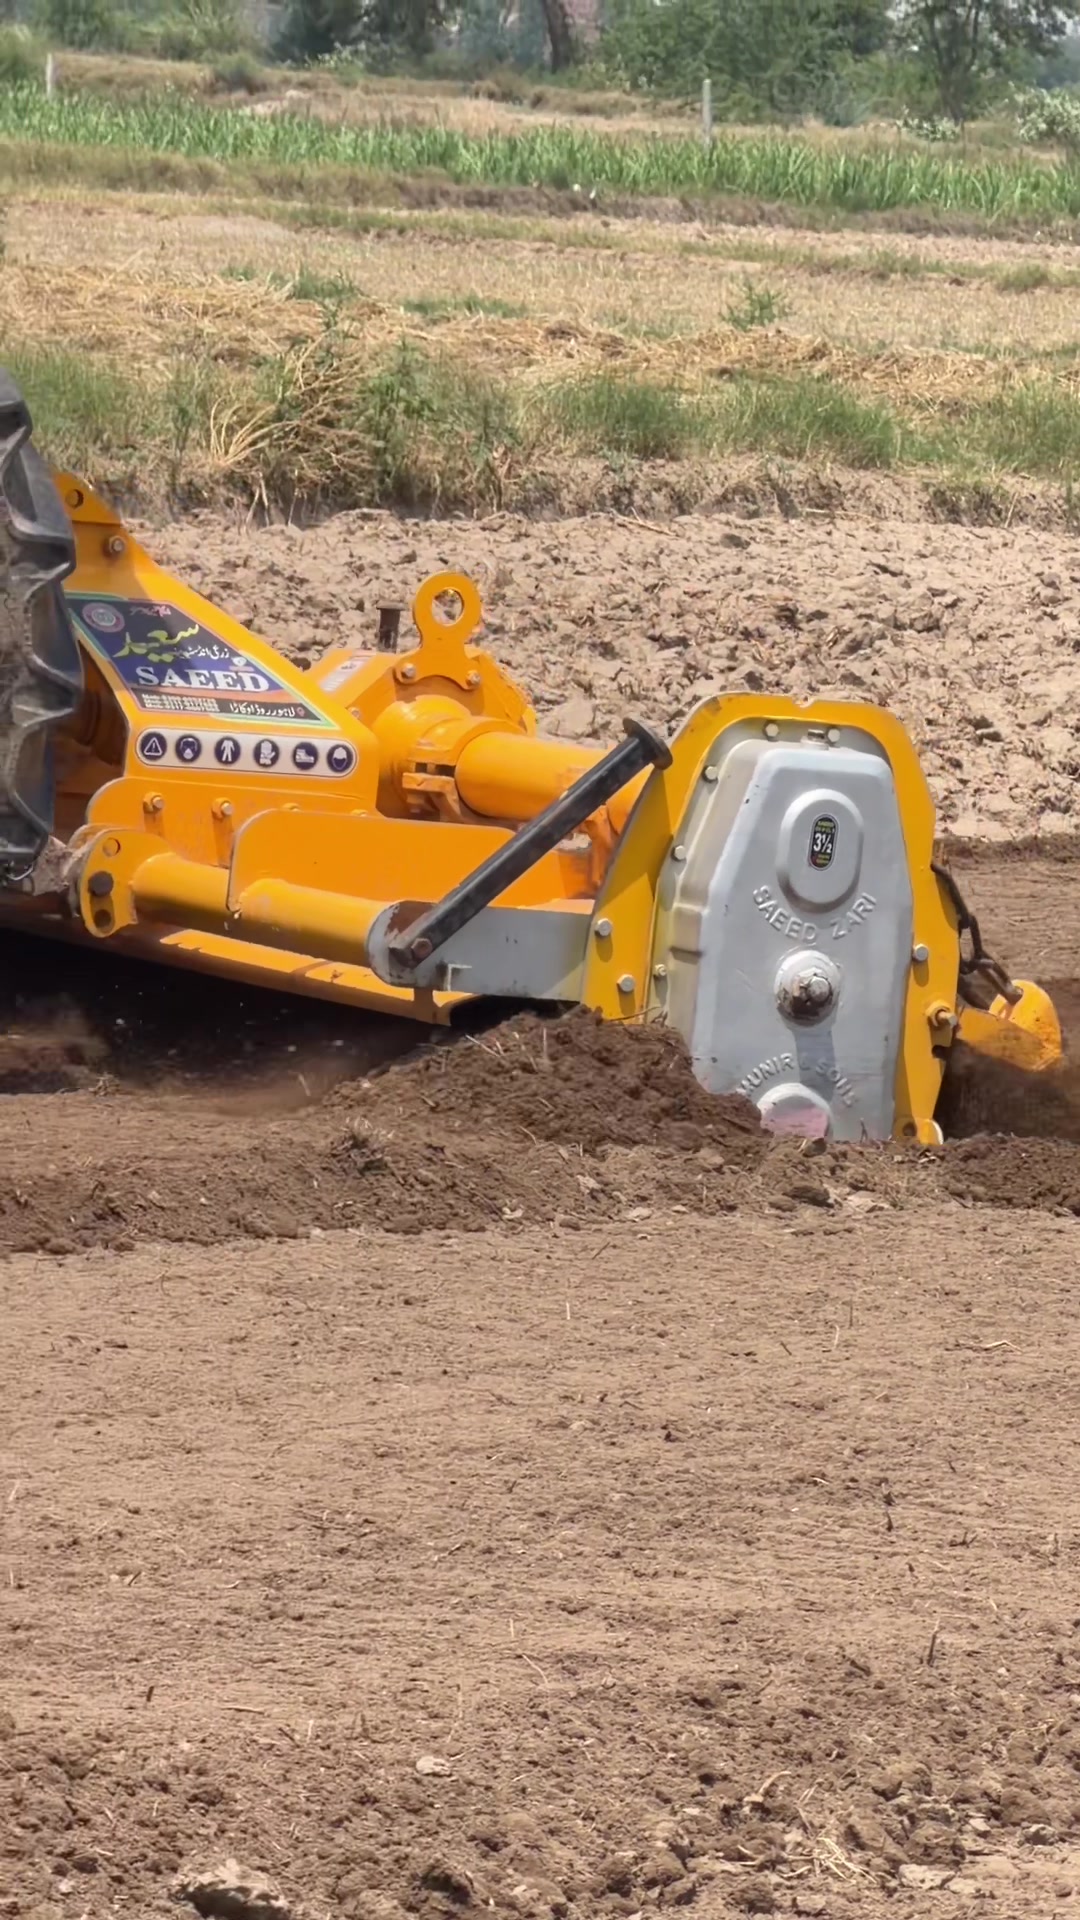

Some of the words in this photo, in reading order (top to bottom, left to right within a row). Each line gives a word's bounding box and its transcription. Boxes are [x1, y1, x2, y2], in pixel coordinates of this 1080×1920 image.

[136, 666, 270, 693] SAEED
[752, 885, 817, 943] SAEED
[829, 892, 877, 940] ZARI
